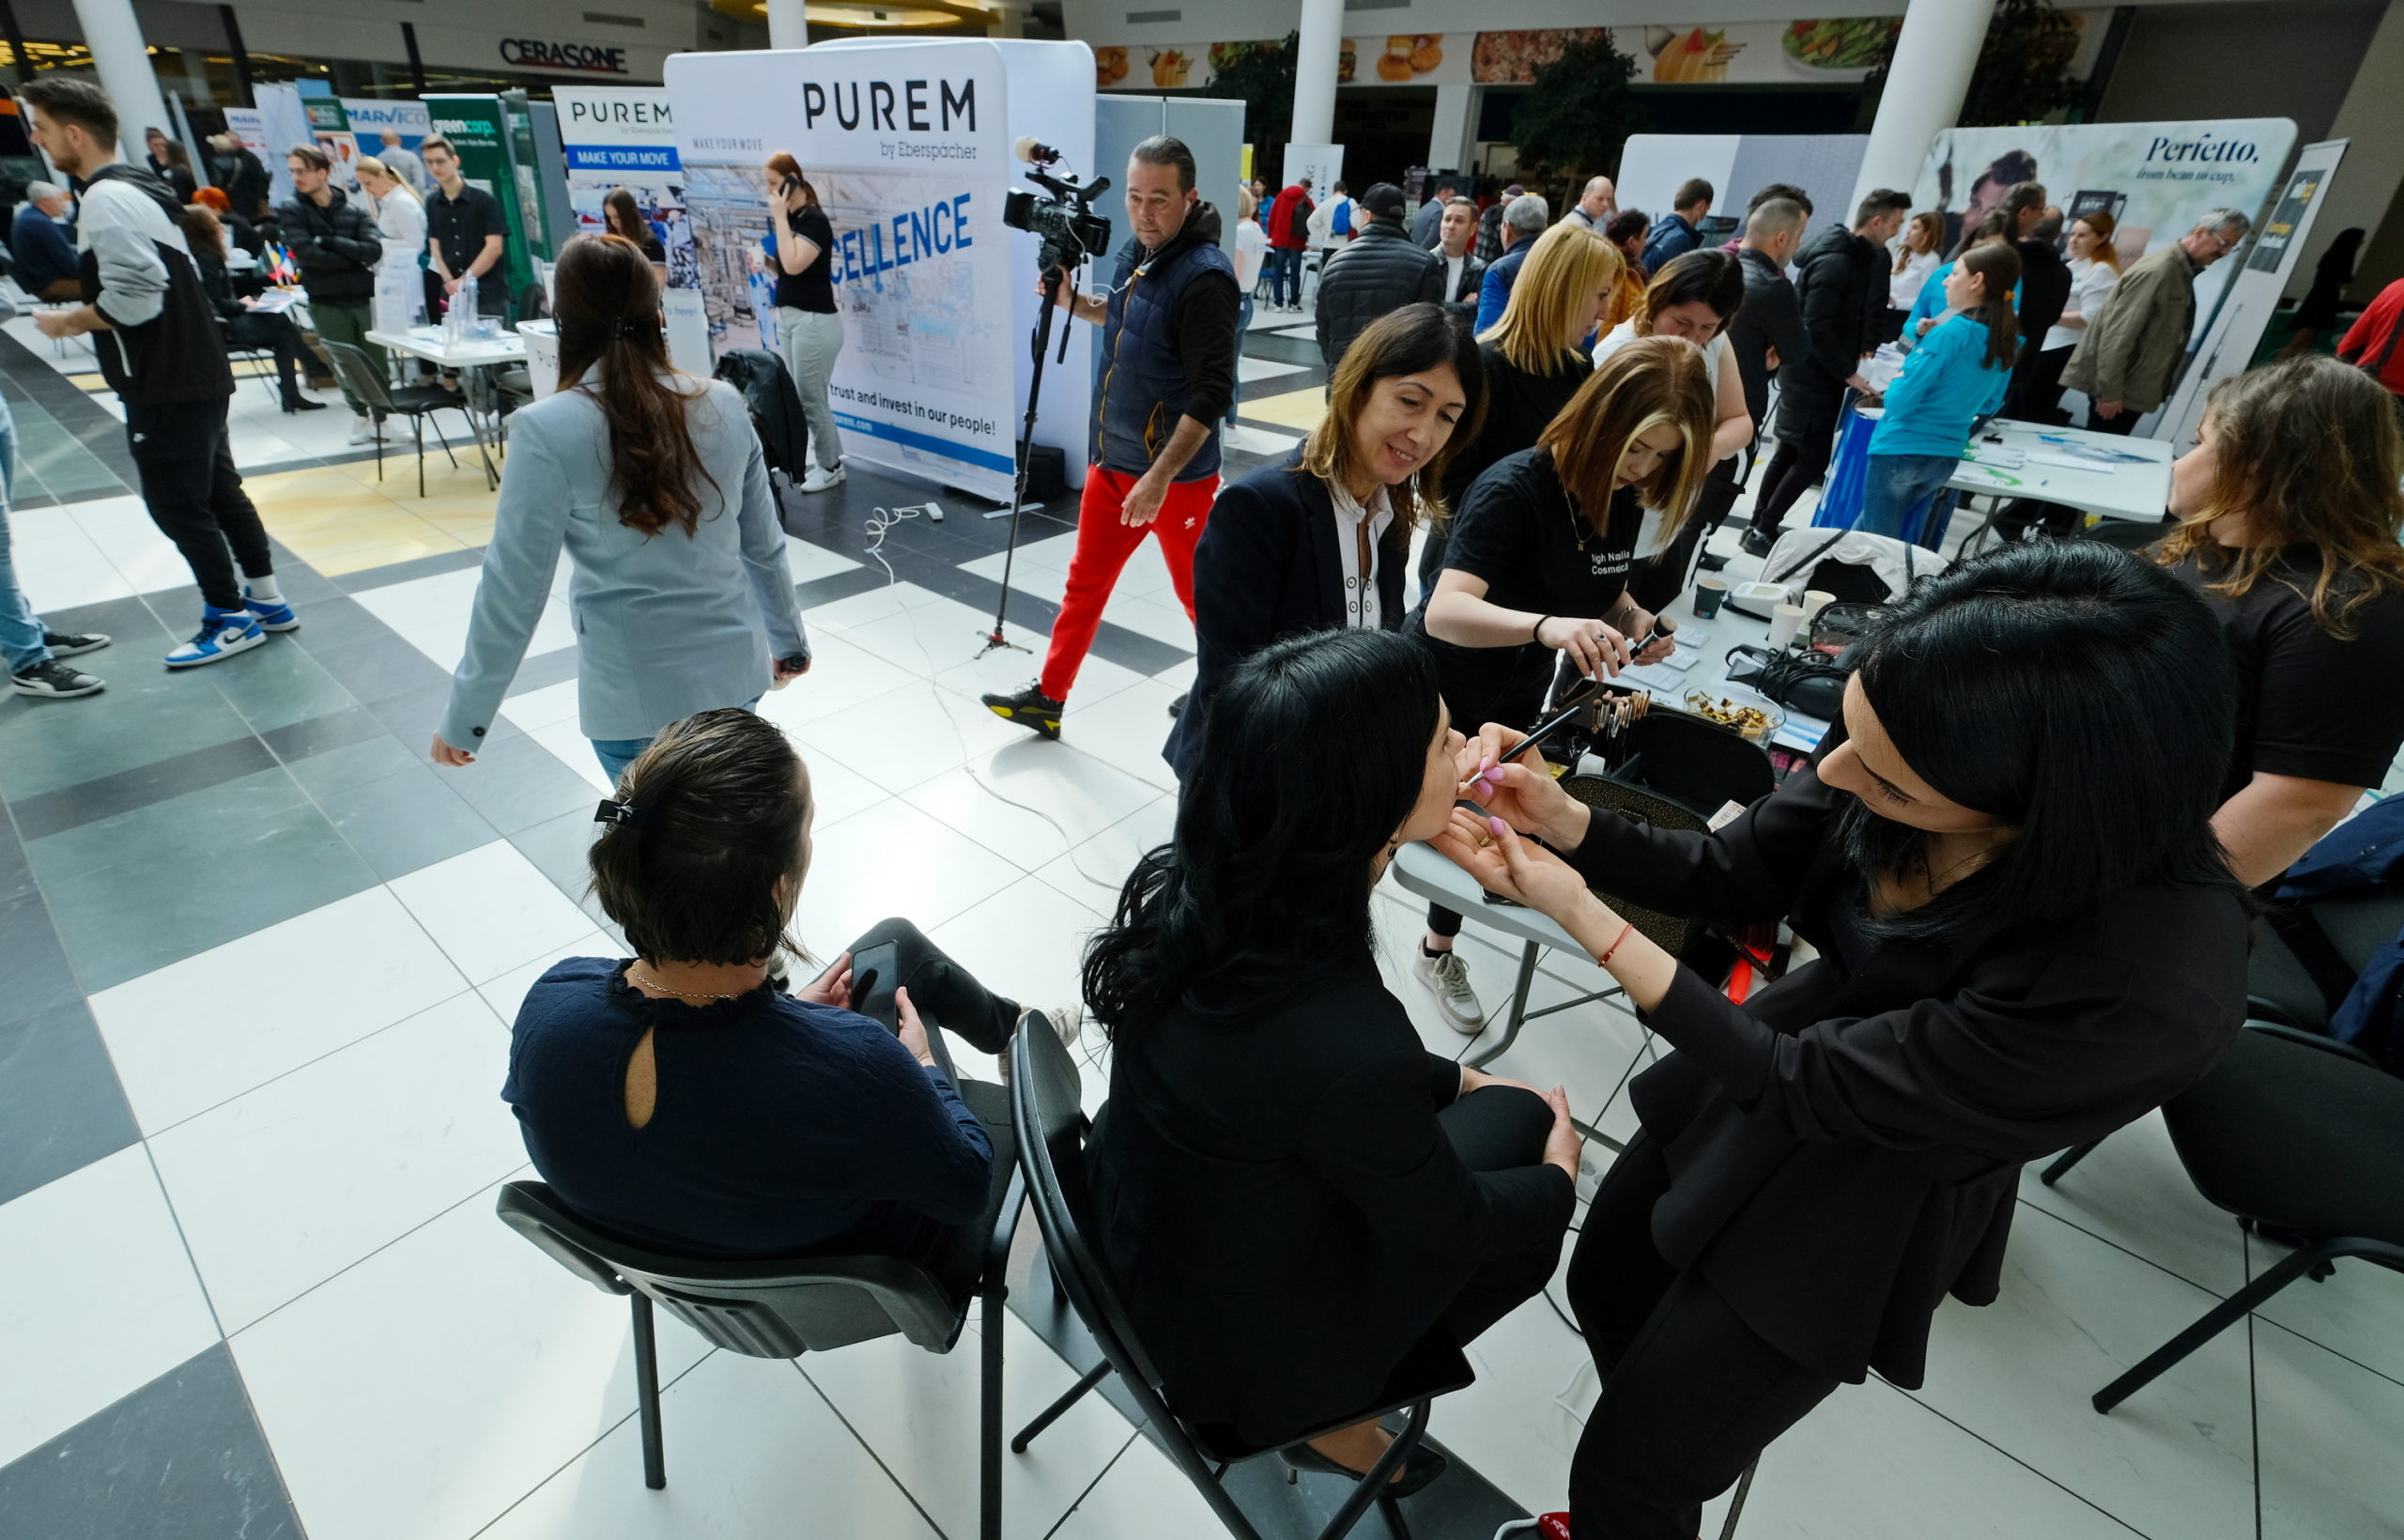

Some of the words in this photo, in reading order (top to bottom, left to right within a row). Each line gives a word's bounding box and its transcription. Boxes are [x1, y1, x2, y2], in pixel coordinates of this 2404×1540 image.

[500, 38, 628, 74] CERASONE
[572, 101, 672, 123] PUREM
[803, 79, 976, 131] PUREM
[577, 150, 609, 163] MAKE
[610, 151, 639, 164] YOUR
[640, 151, 669, 165] MOVE
[693, 138, 715, 148] MAKE
[716, 138, 737, 150] YOUR
[739, 139, 763, 150] MOVE
[880, 141, 895, 159] by
[899, 142, 977, 161] Eberspächer
[2145, 133, 2259, 163] Perfetto,
[829, 192, 972, 284] CELLENCE
[830, 383, 855, 400] trust
[857, 392, 877, 406] and
[879, 393, 912, 415] invest
[915, 402, 925, 417] in
[928, 408, 948, 423] our
[950, 413, 995, 436] people!
